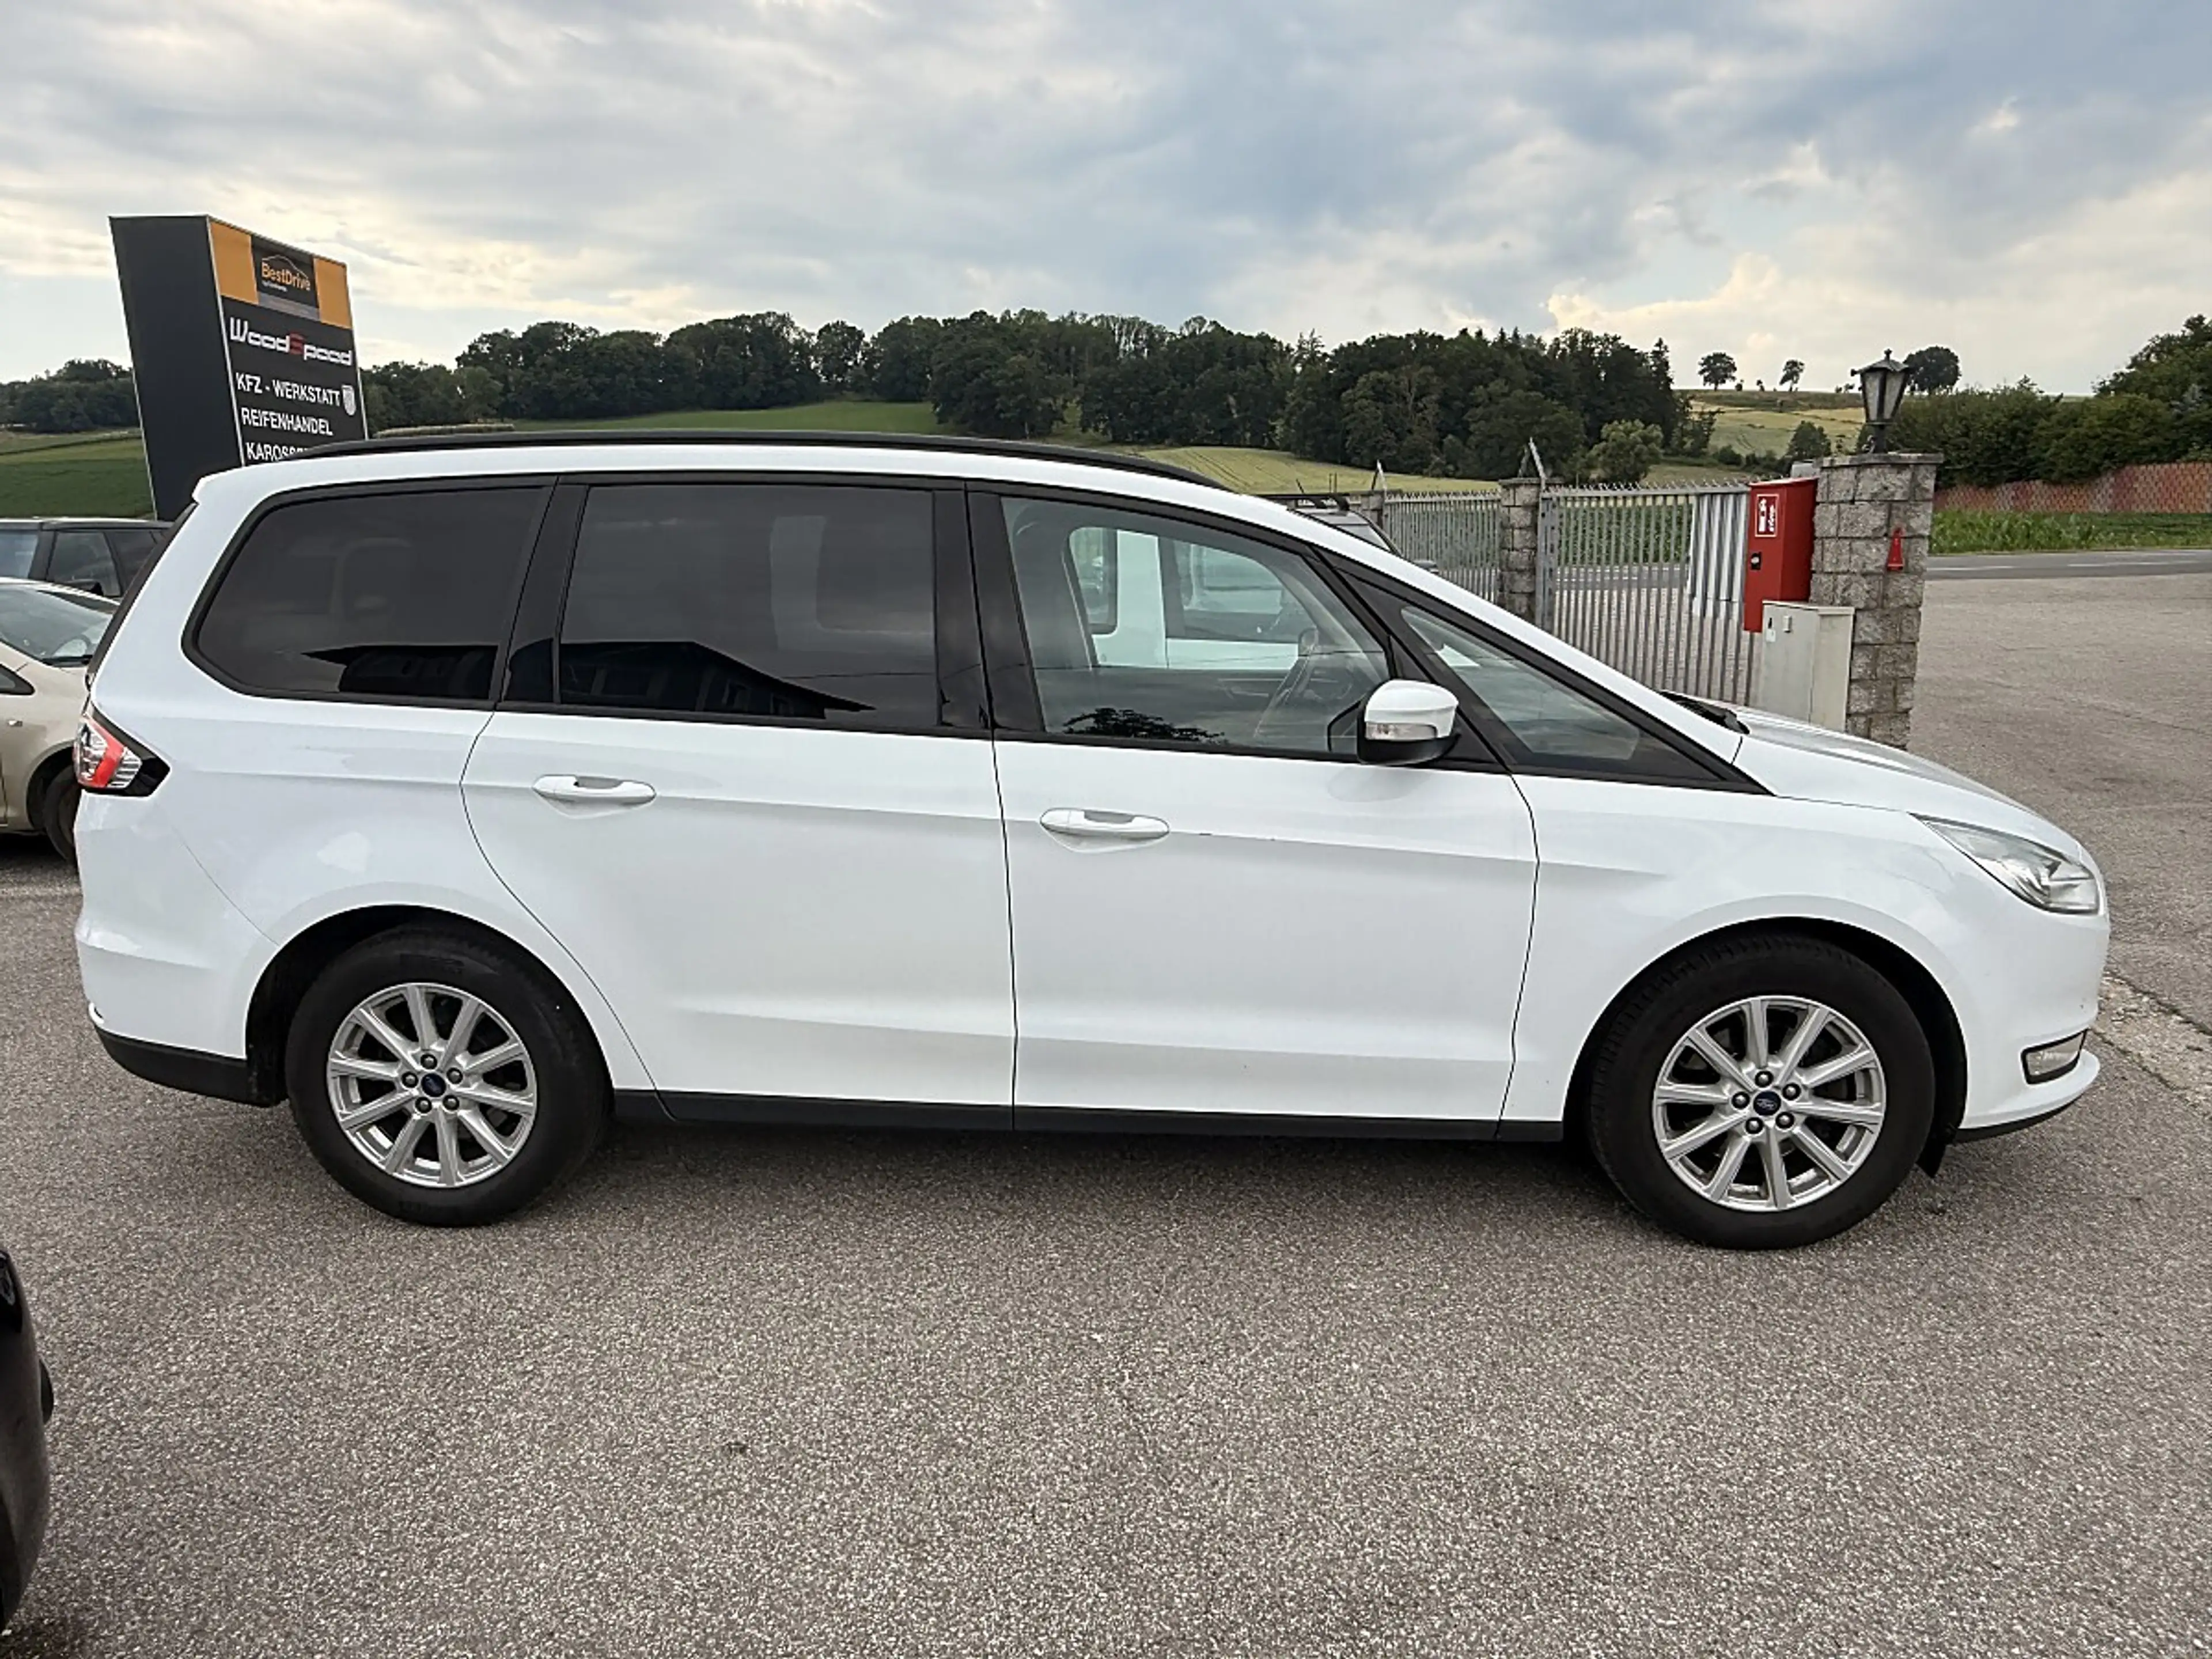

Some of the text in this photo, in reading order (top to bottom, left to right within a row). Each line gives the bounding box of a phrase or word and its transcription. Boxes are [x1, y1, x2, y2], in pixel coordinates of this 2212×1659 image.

[236, 372, 263, 394] KFZ
[272, 380, 340, 407] WERKSTATT
[241, 407, 334, 437] REIFENHANDEL
[245, 442, 308, 461] KAROS
